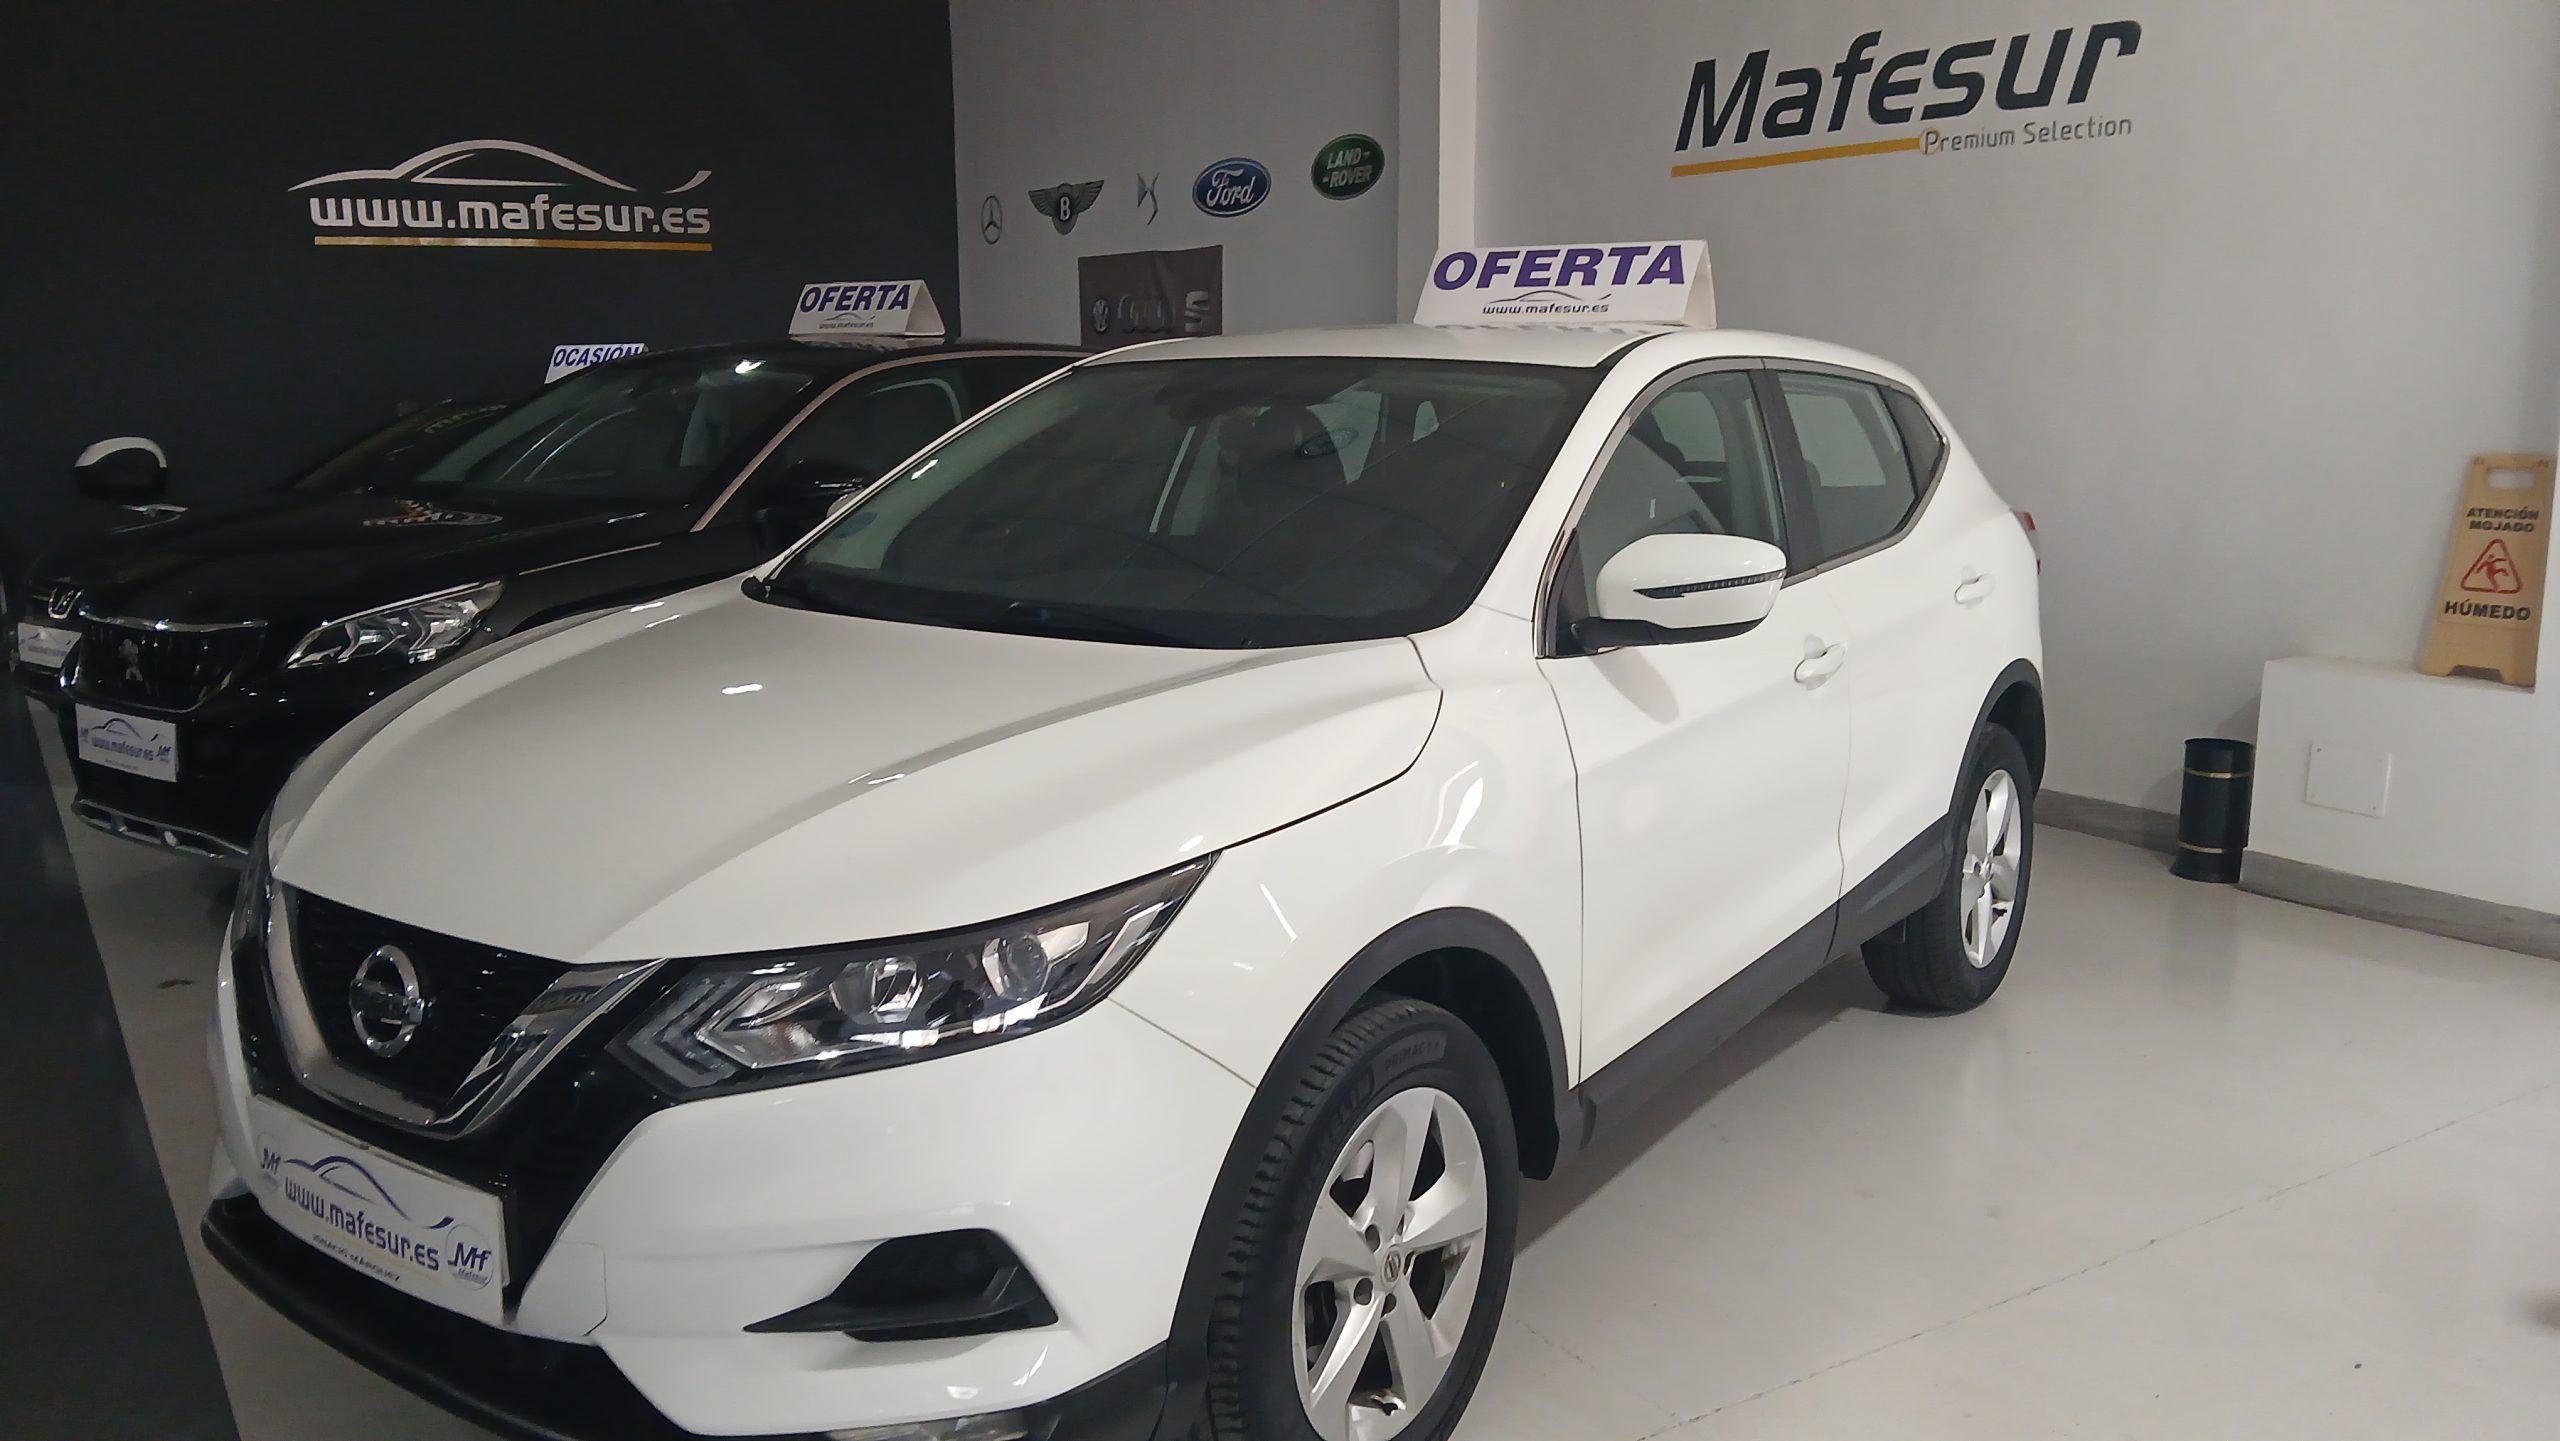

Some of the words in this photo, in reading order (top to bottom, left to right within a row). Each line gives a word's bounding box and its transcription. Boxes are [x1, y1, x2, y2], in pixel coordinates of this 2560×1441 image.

[1674, 20, 2141, 152] Mafesur
[1923, 128, 2015, 154] Premium
[2023, 116, 2133, 145] Selection
[1206, 169, 1255, 207] Ford
[310, 194, 712, 234] www.mafesur.es
[1433, 245, 1685, 290] OFERTA
[801, 285, 911, 313] OFERTA
[1482, 302, 1610, 315] www.mafesur.es
[2467, 506, 2540, 520] ATENCIÓN
[2469, 520, 2535, 532] MOJADO
[2444, 599, 2531, 620] HÚMEDO
[284, 1176, 440, 1271] www.mafesur.es
